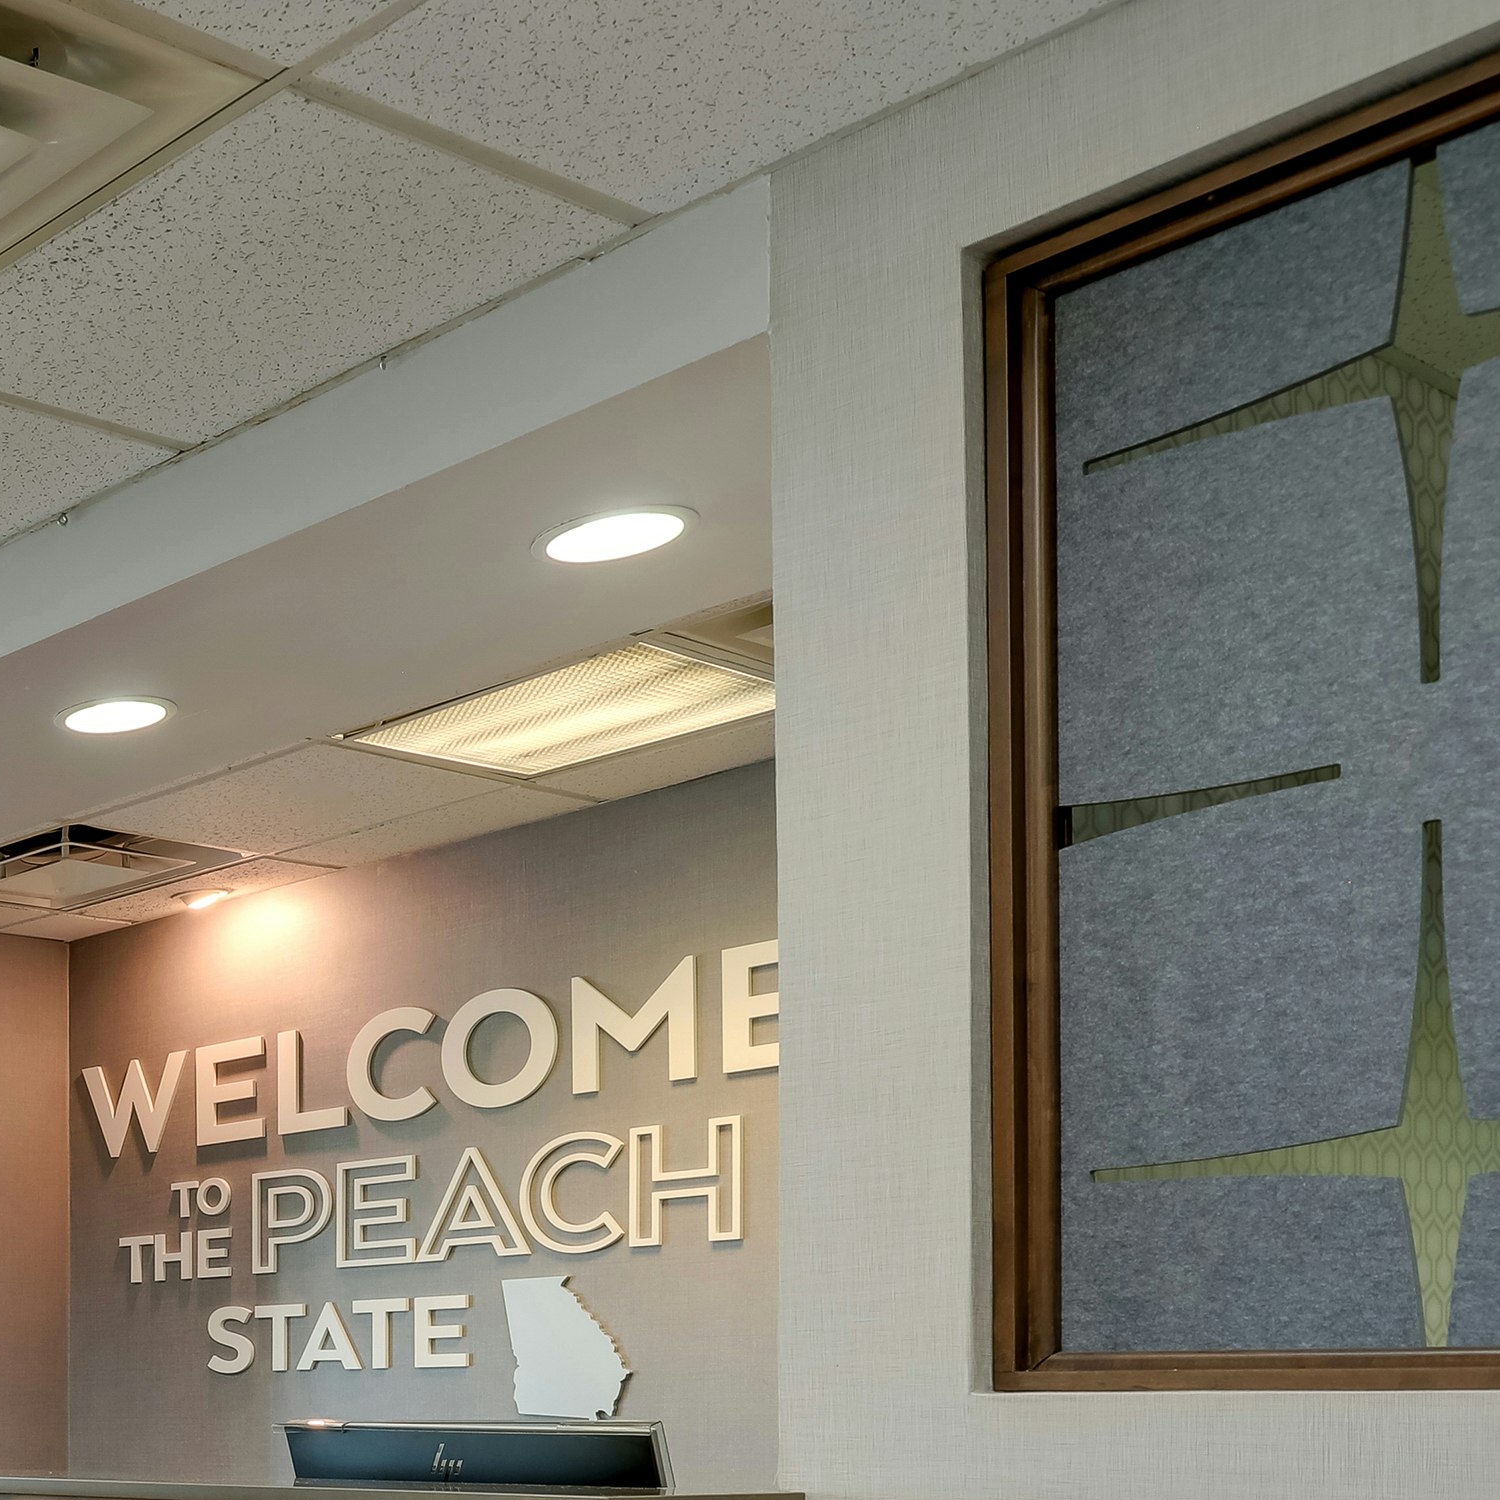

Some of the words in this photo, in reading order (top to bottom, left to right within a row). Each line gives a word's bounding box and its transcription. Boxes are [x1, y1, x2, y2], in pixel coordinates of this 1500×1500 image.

[81, 939, 779, 1158] WELCOME
[170, 1176, 232, 1219] TO
[251, 1114, 744, 1275] PEACH
[118, 1227, 233, 1284] THE
[206, 1294, 472, 1375] STATE
